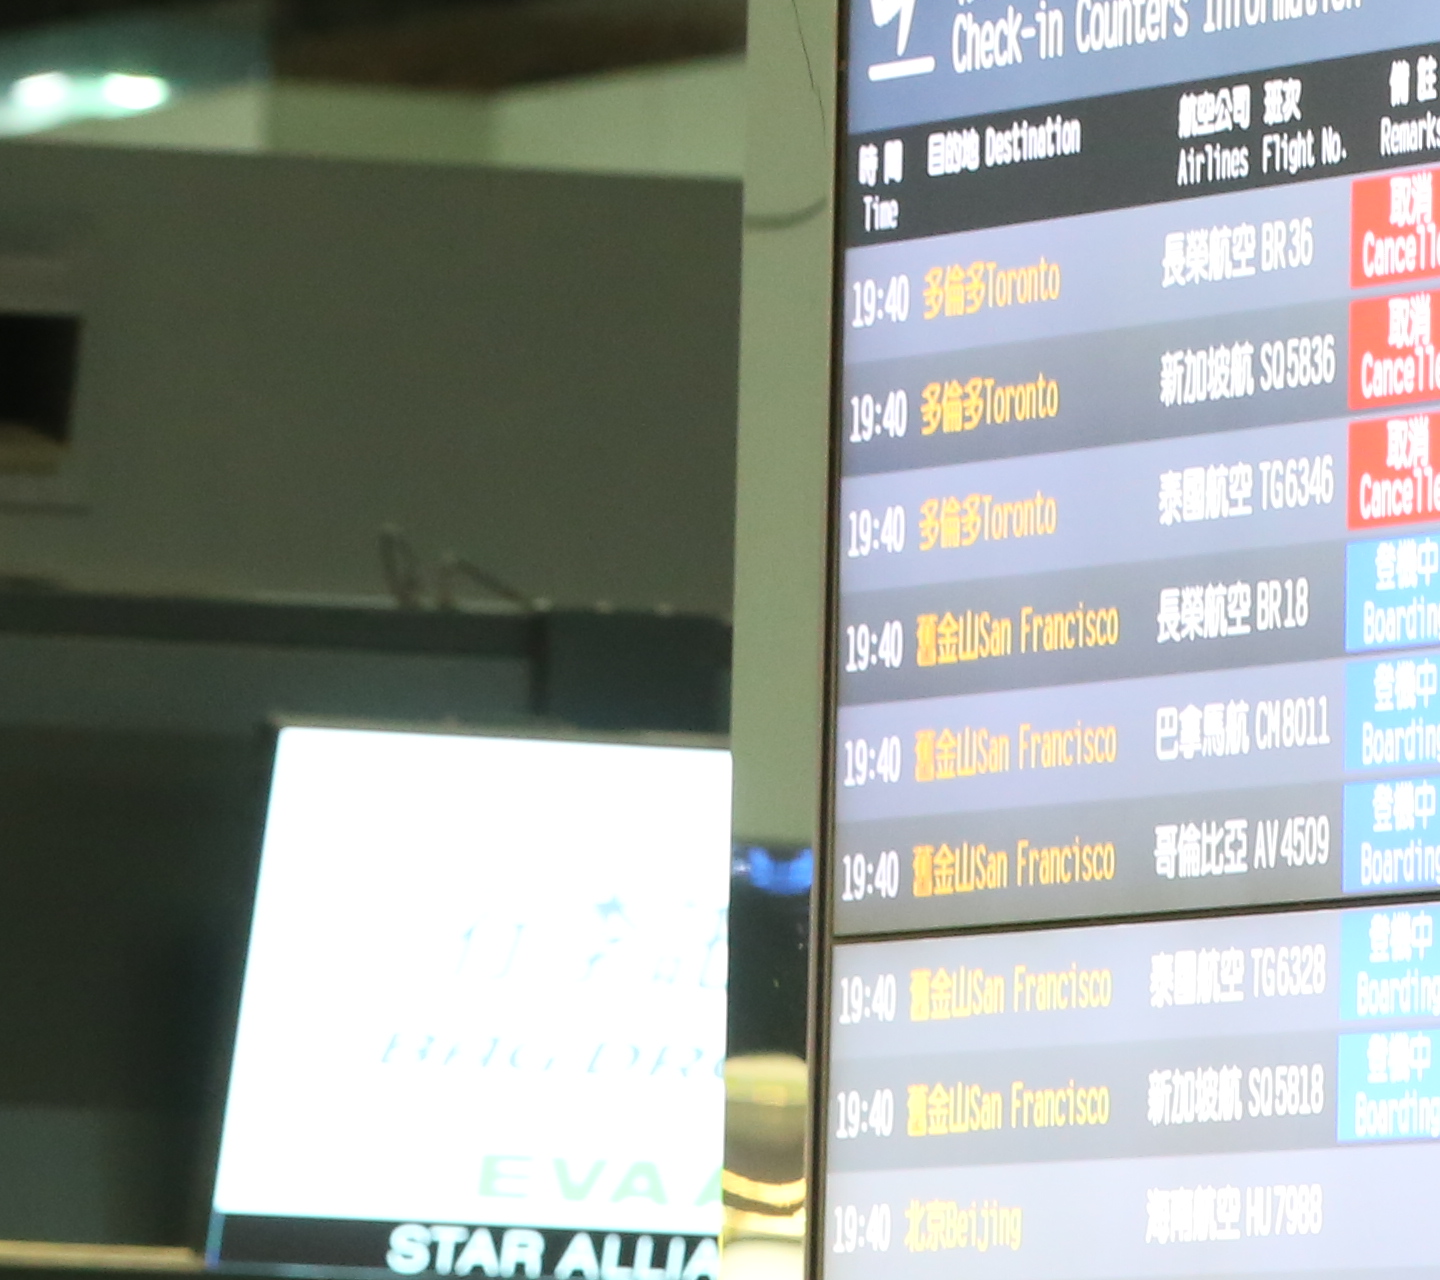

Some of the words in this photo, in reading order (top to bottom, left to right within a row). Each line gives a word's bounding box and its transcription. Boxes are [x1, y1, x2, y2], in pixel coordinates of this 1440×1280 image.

[951, 4, 1064, 73] Check-in
[984, 114, 1081, 167] Destination
[1177, 143, 1249, 187] Airlines
[1261, 128, 1315, 175] Flight
[1321, 125, 1348, 166] No.
[863, 195, 899, 232] Time
[1389, 173, 1433, 227] 取消
[852, 274, 910, 327] 19:40
[1162, 222, 1256, 287] 長榮航空
[846, 619, 903, 671] 19:40
[1020, 601, 1119, 654] Francisco
[1156, 580, 1251, 643] 長榮航空
[477, 1154, 669, 1206] EVA
[385, 1223, 546, 1280] STAR
